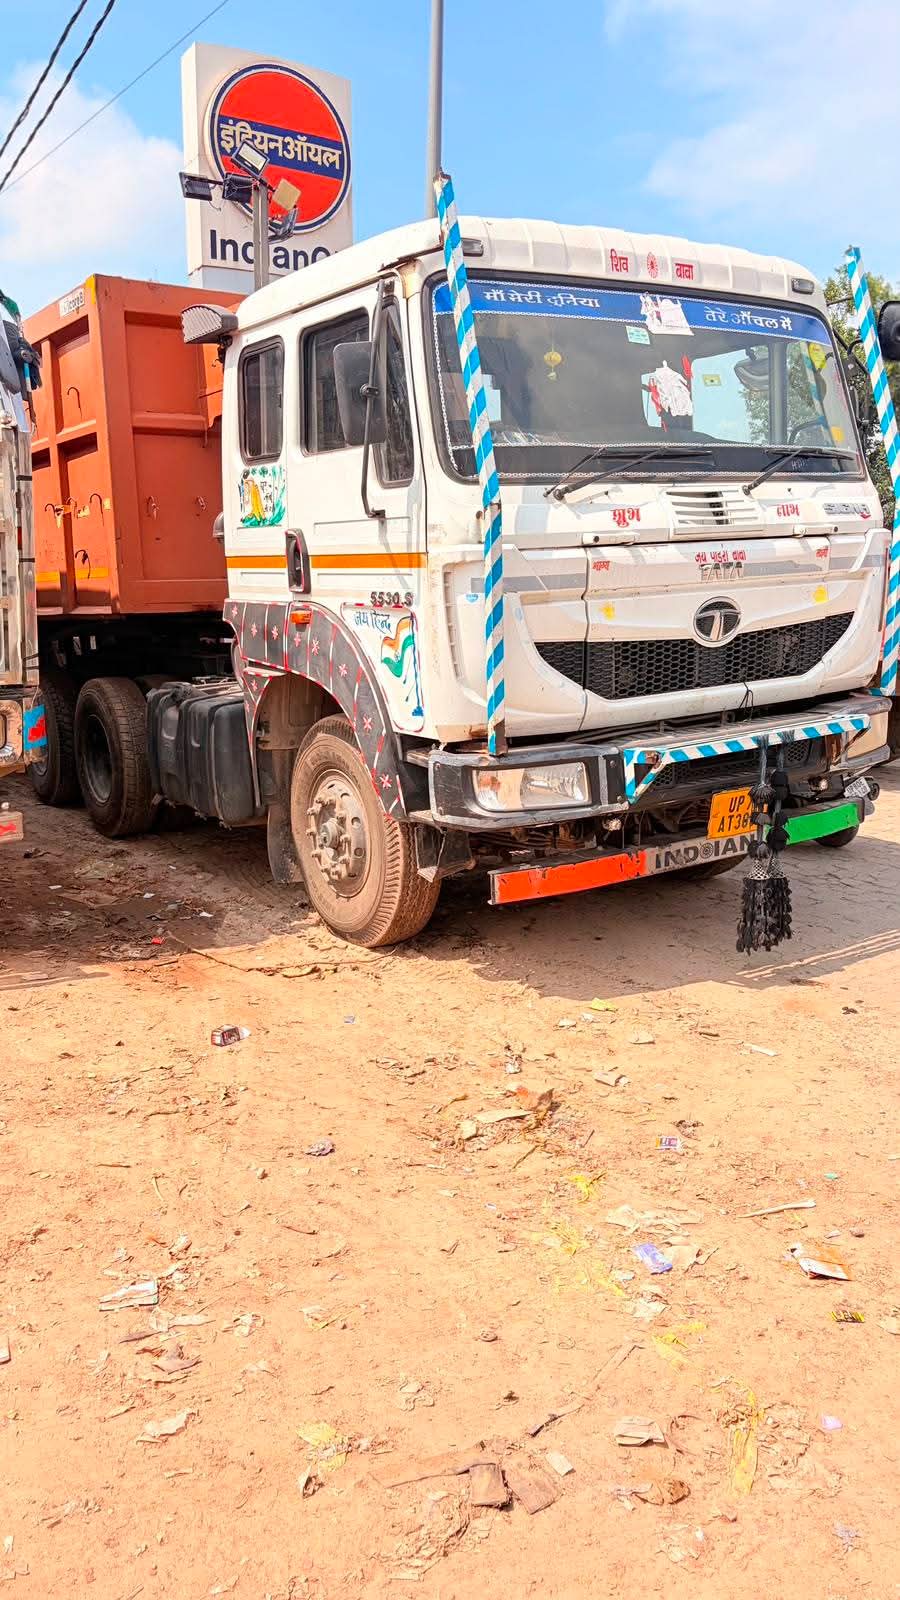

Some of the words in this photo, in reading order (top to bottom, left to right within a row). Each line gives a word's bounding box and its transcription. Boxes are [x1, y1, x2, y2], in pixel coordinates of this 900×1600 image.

[610, 248, 629, 273] शिव
[507, 289, 543, 304] मेरी
[703, 305, 728, 323] तेरे
[699, 561, 744, 583] TATA
[354, 611, 369, 627] जय
[728, 795, 745, 813] UP
[717, 812, 757, 833] AT38
